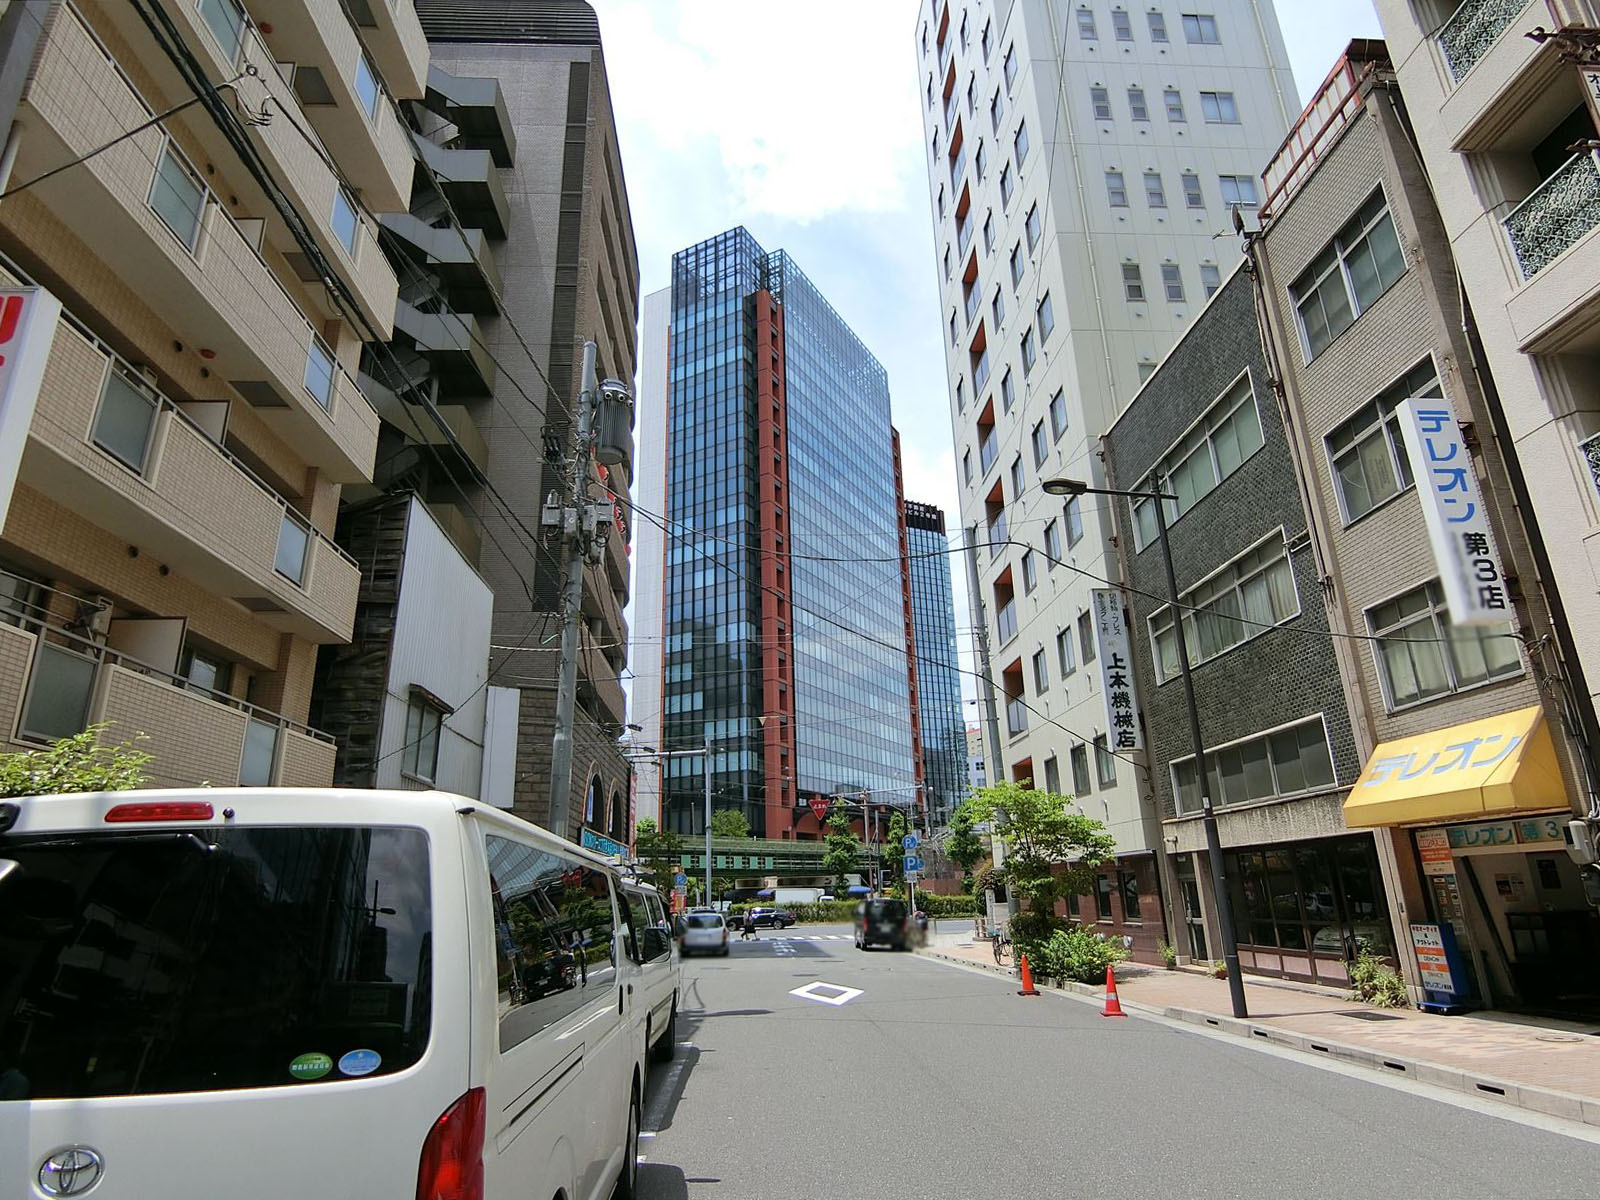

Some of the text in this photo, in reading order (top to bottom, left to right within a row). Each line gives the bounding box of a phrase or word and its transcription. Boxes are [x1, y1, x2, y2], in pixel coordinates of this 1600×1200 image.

[1417, 410, 1474, 522] テレオン
[1107, 653, 1136, 748] 上本機械店
[1363, 734, 1519, 787] テレオン
[1451, 827, 1512, 846] テレオン
